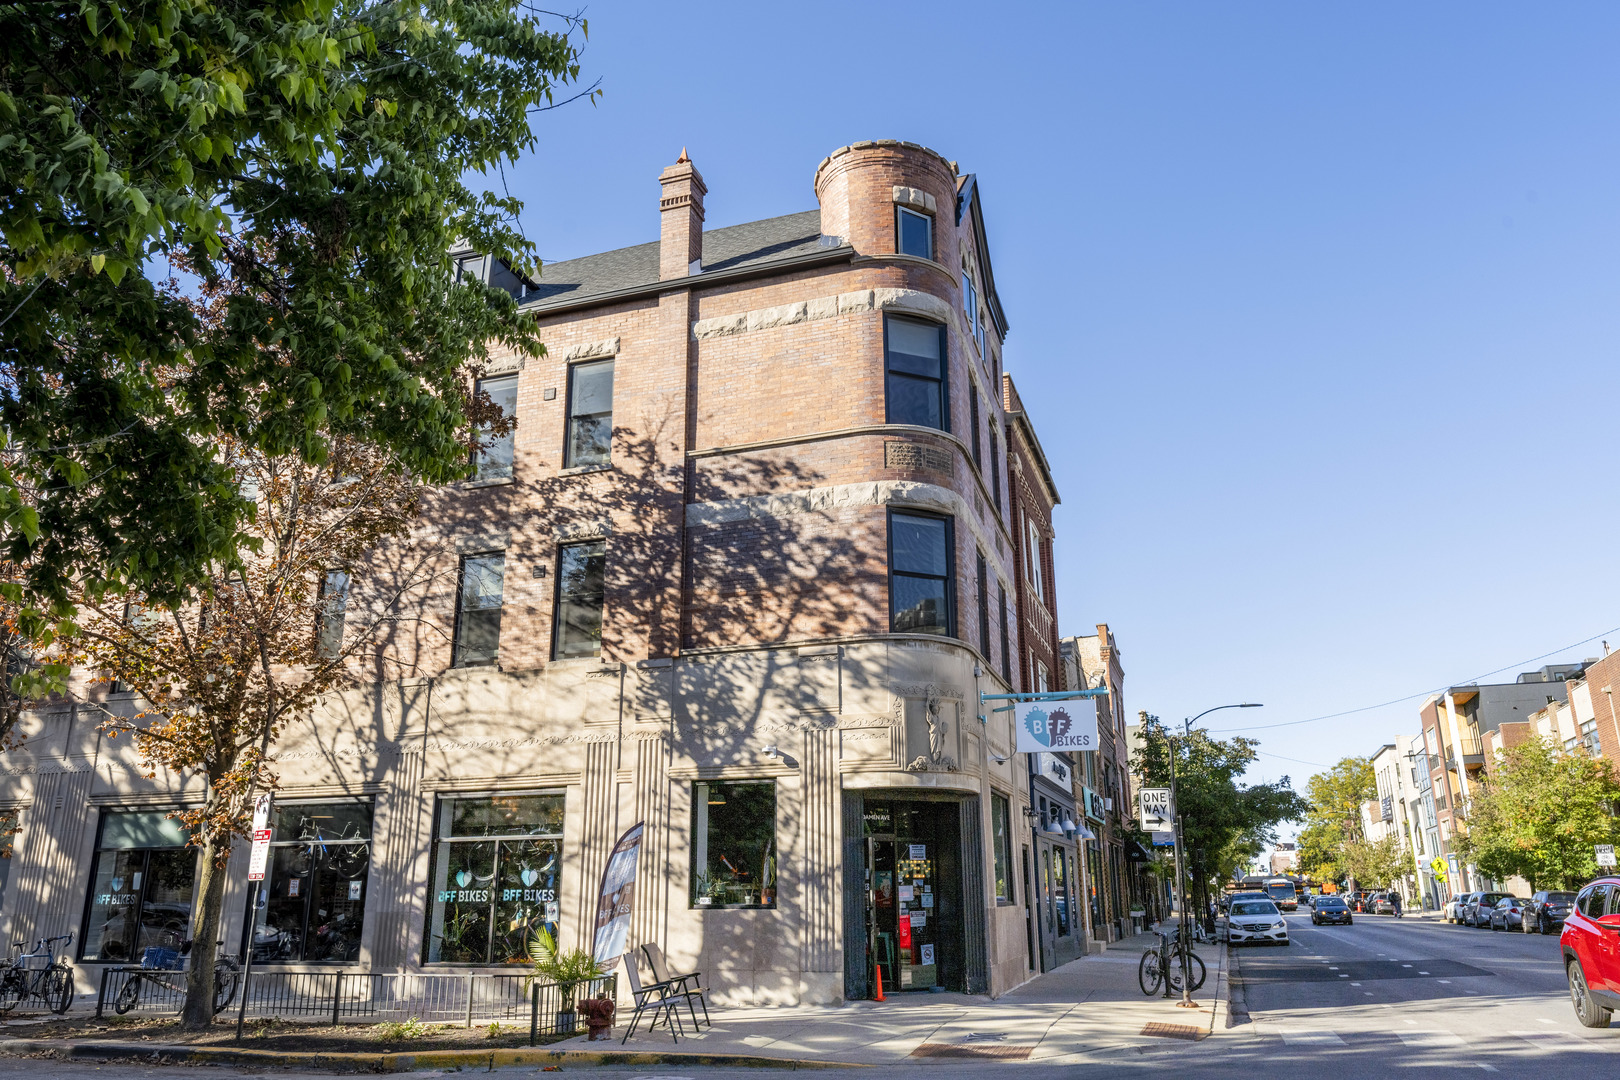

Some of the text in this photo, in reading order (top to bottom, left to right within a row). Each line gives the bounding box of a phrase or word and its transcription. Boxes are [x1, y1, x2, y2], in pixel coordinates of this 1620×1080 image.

[1033, 719, 1066, 735] BFF
[1056, 735, 1090, 747] BIKES
[1143, 792, 1167, 803] ONE
[1143, 804, 1168, 814] WAY
[96, 894, 136, 904] BFF BIKES
[438, 890, 488, 903] BFF BIKES
[503, 889, 555, 902] BFF BIKES
